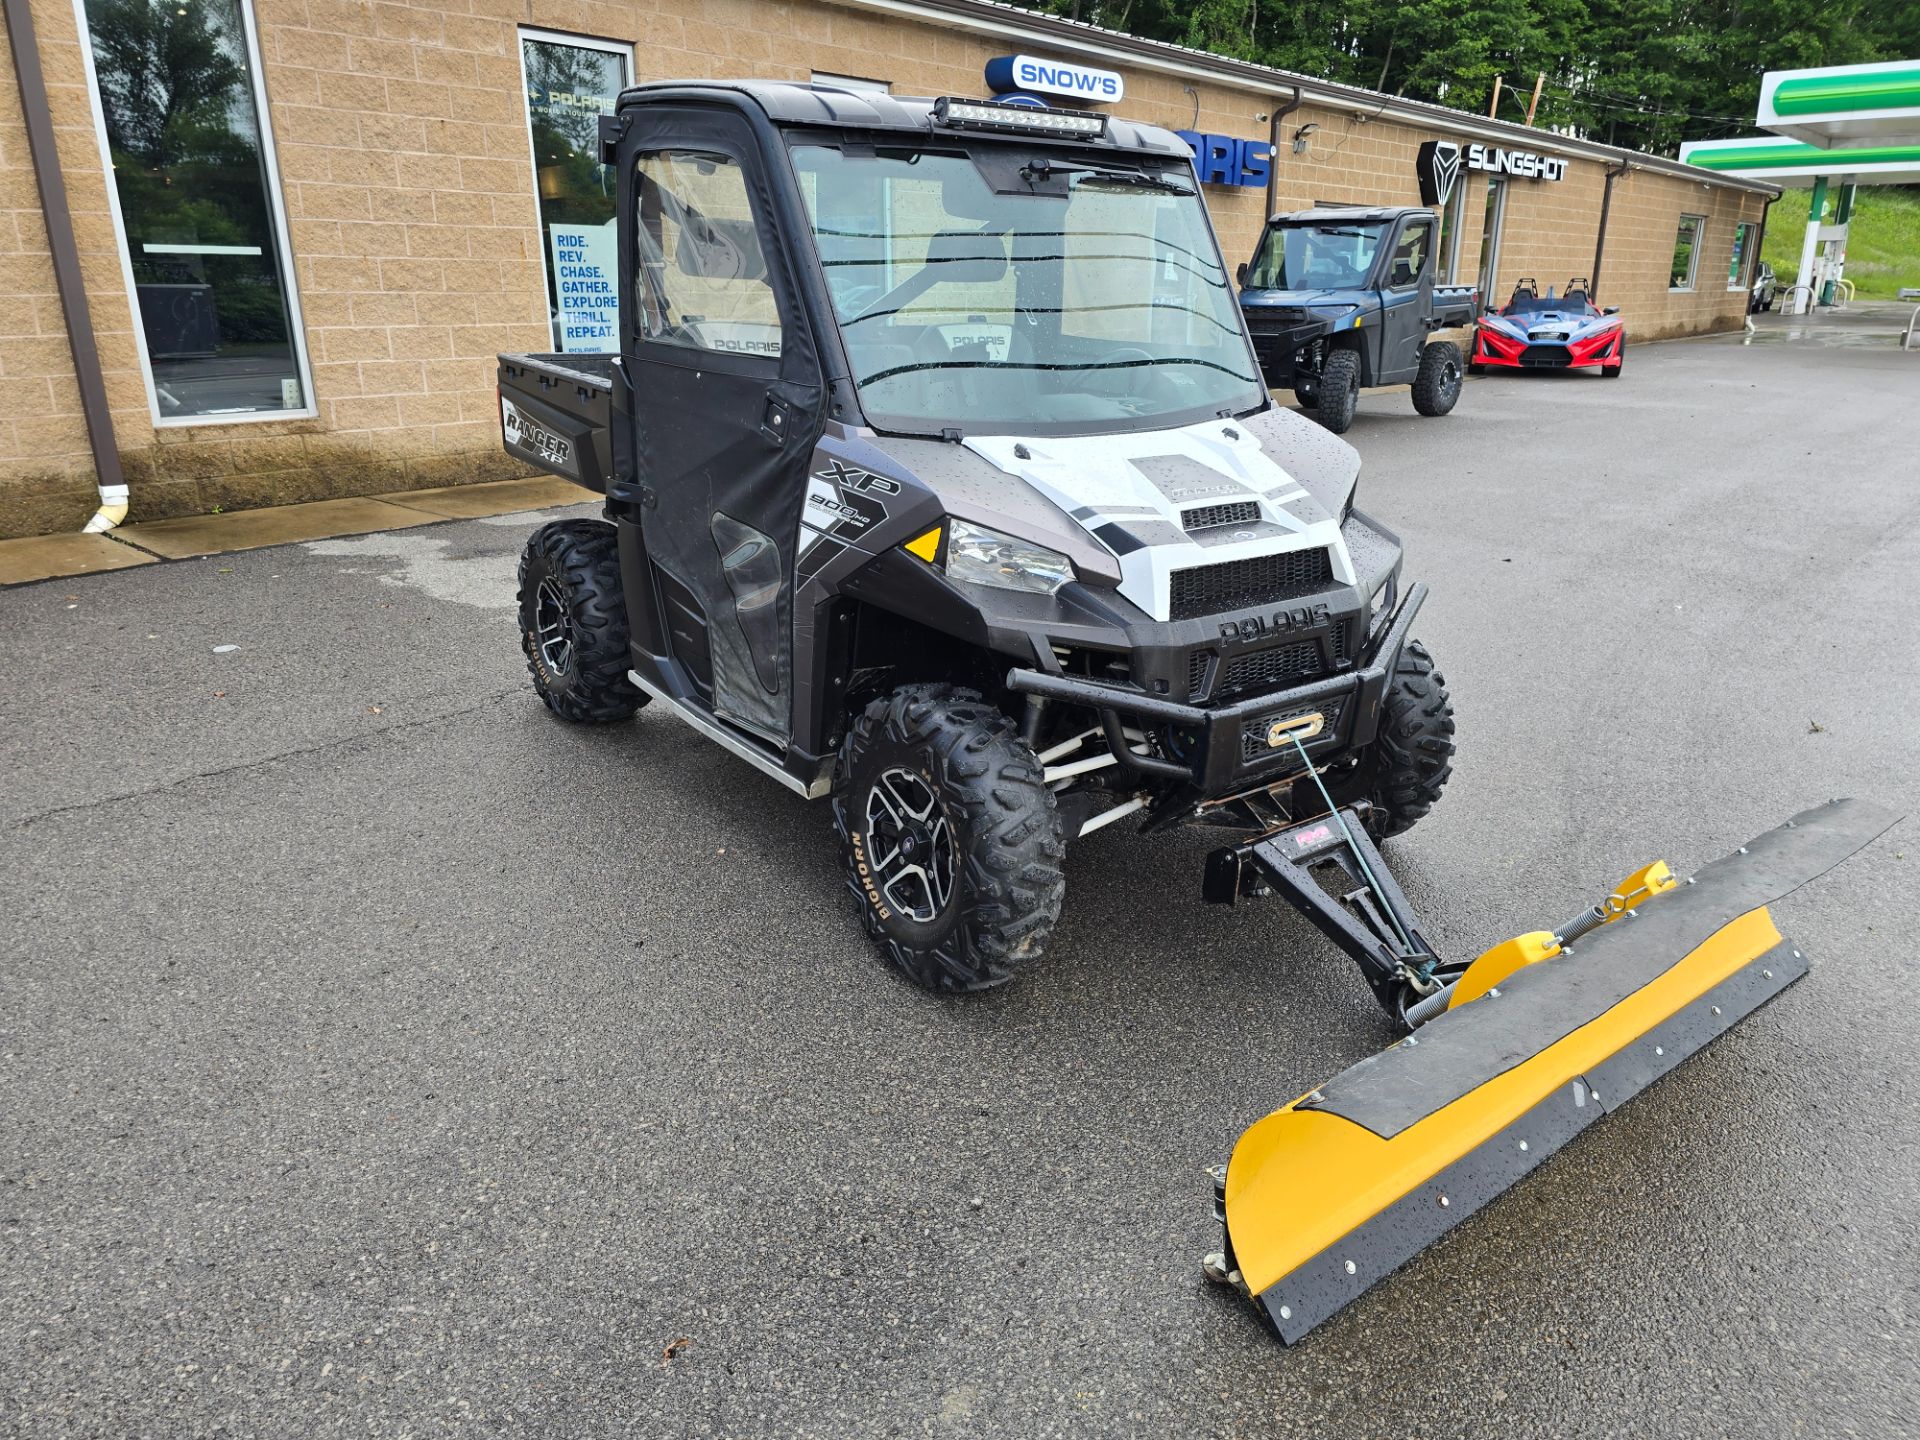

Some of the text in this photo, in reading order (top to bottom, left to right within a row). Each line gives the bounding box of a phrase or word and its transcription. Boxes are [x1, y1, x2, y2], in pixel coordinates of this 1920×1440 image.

[1020, 63, 1117, 95] SNOW'S
[548, 91, 616, 110] POLARIS
[1467, 143, 1569, 181] SLINGSHOT
[557, 235, 589, 248] RIDE.
[559, 250, 586, 263] REV.
[560, 266, 604, 278] CHASE.
[562, 281, 613, 293] GATHER.
[565, 311, 611, 323] THRILL.
[567, 326, 615, 338] REPEAT.
[953, 335, 1006, 345] POLARIS
[714, 339, 781, 352] POLARIS
[505, 412, 570, 461] RANGER
[540, 448, 564, 465] XP
[815, 458, 902, 497] XP
[1218, 602, 1331, 648] POLARIS
[527, 630, 551, 685] BIGHORN
[851, 830, 892, 921] BIGHORN
